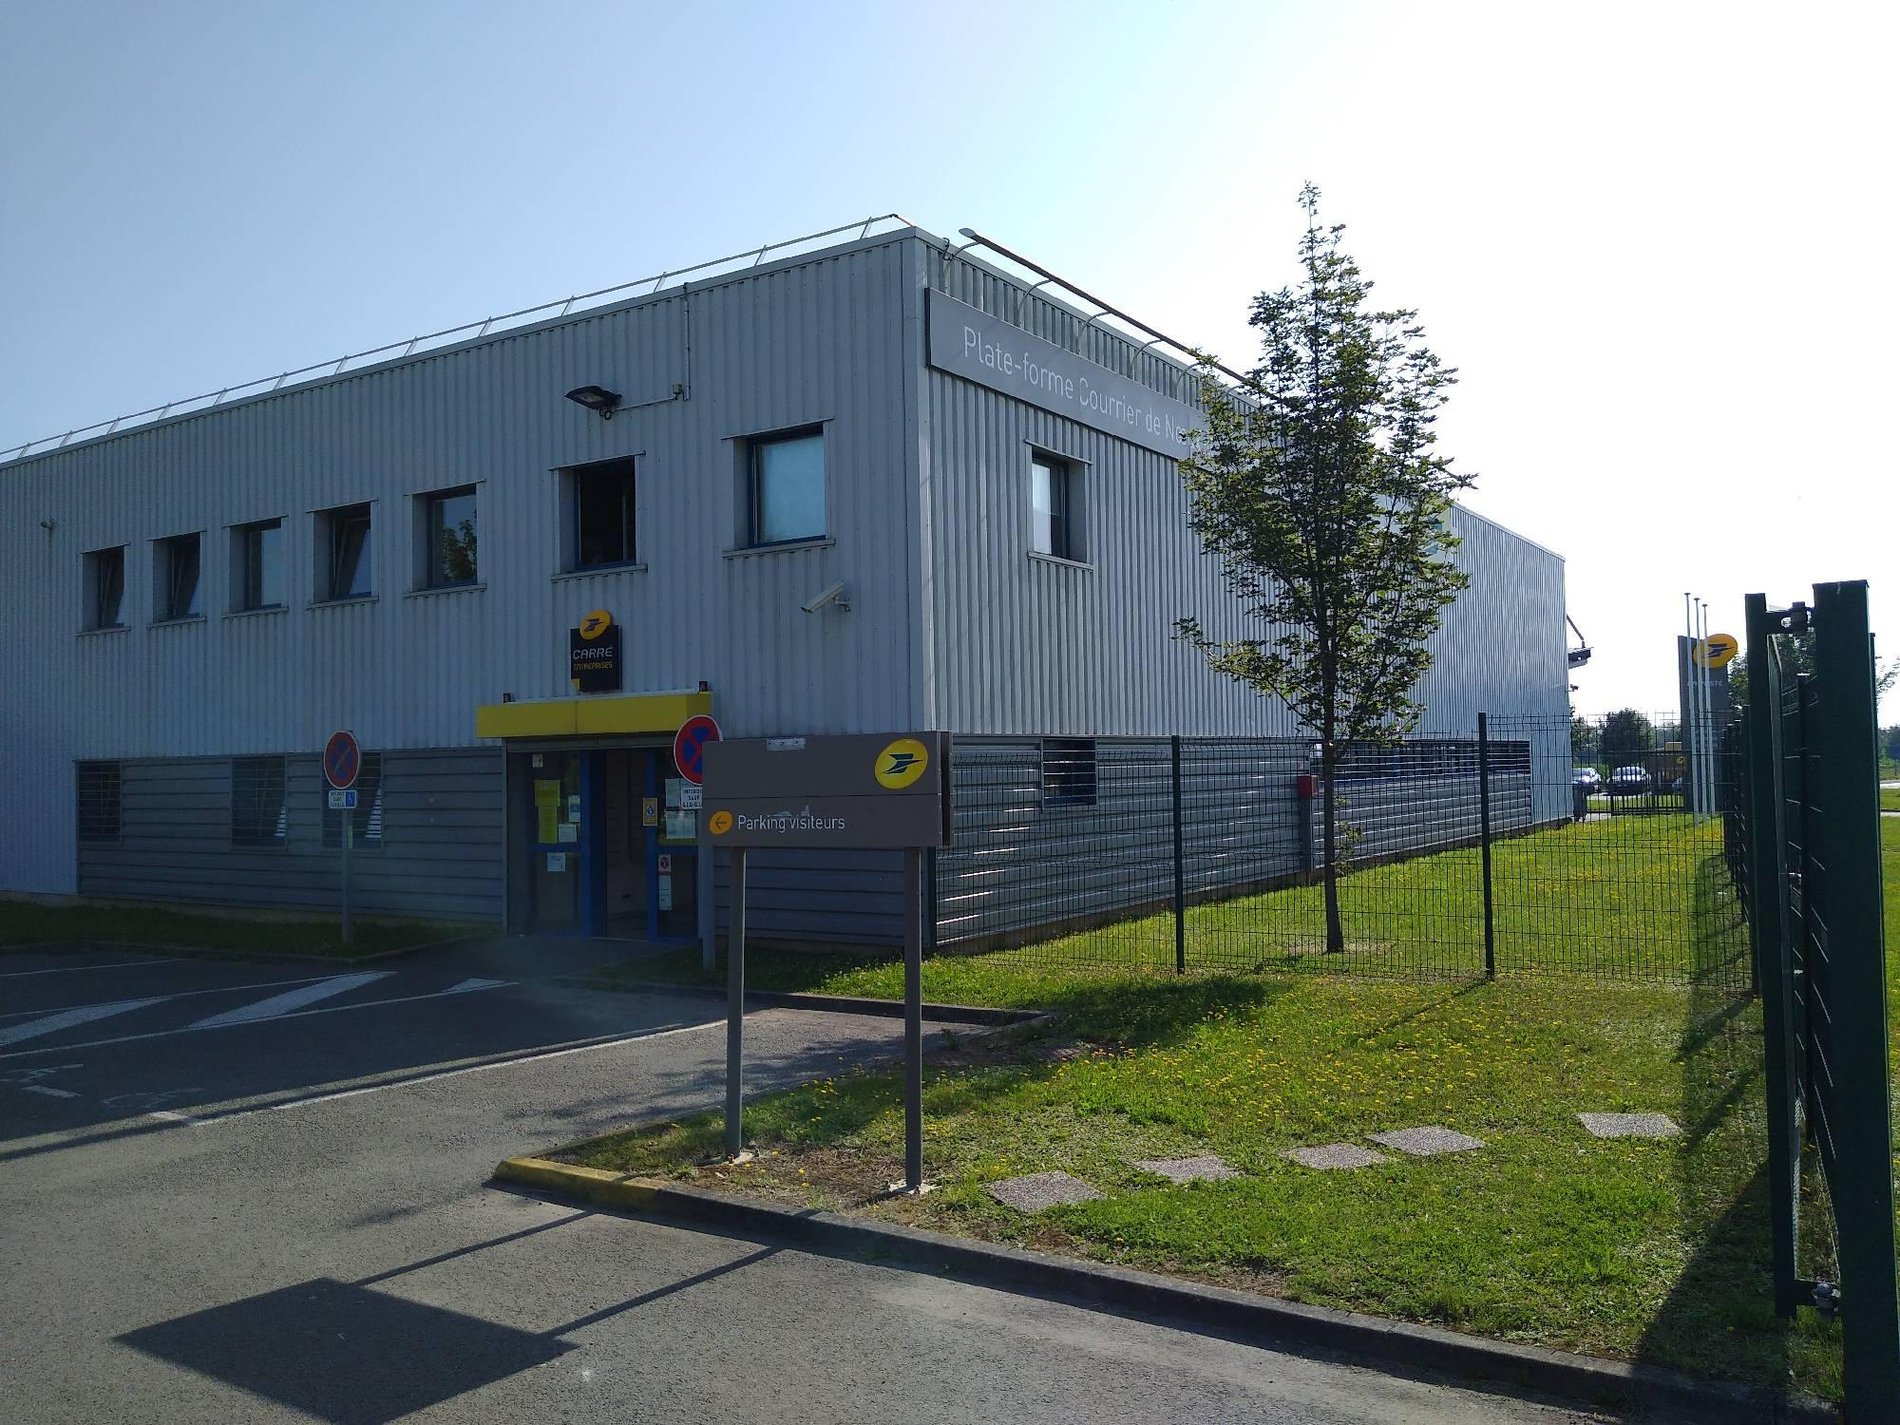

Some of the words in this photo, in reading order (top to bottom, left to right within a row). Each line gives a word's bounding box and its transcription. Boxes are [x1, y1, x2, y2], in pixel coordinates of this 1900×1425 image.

[963, 325, 1074, 400] Plate-forme
[1079, 377, 1142, 427] Courrier
[1146, 412, 1161, 436] de
[573, 660, 613, 671] ENTREPRISES
[738, 814, 786, 834] Parking
[789, 814, 846, 831] visiteurs
